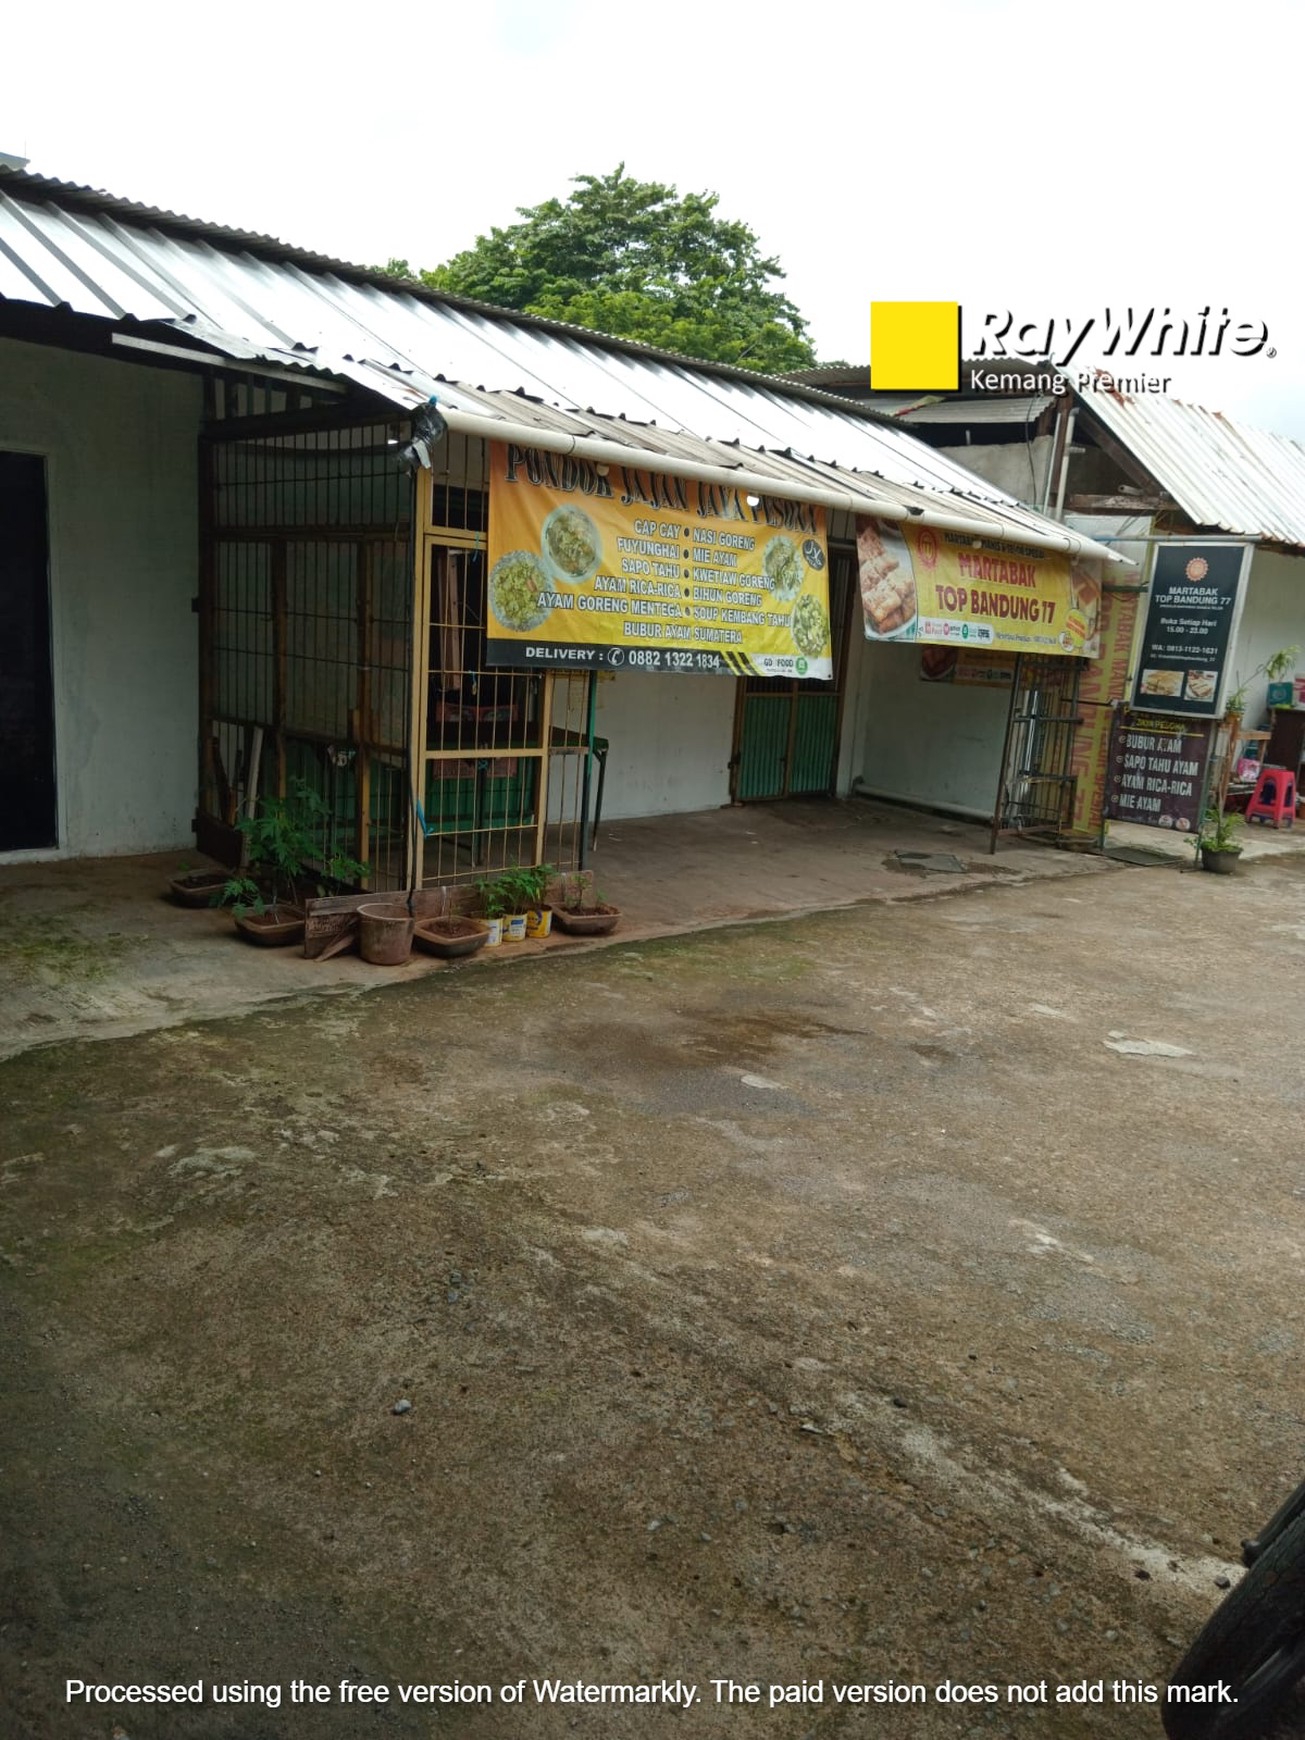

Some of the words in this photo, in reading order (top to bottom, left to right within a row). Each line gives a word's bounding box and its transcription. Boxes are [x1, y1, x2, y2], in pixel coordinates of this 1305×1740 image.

[634, 519, 657, 535] CAP
[659, 523, 681, 539] CAY
[693, 528, 717, 545] NASI
[718, 532, 756, 550] GORENG
[617, 538, 680, 560] FUYUNGHAI
[693, 548, 711, 563] MIE
[713, 551, 738, 567] AYAM
[622, 558, 650, 574] SAPO
[652, 563, 681, 579] TAHU
[693, 568, 737, 586] KWETIAW
[739, 575, 776, 591] GORENG
[958, 552, 1036, 588] MARTABAK
[594, 575, 627, 593] AYAM
[629, 579, 682, 598] RICA-RICA
[693, 586, 723, 603] BIHUN
[726, 591, 763, 607] GORENG
[935, 585, 968, 612] TOP
[971, 589, 1040, 622] BANDUNG
[1155, 594, 1173, 604] TOP
[1174, 595, 1218, 605] BANDUNG
[1219, 597, 1232, 605] 77
[1168, 586, 1219, 596] MARTABAK
[537, 592, 575, 609] AYAM
[577, 595, 628, 613] GORENG
[631, 599, 683, 617] MENTEGA
[694, 607, 718, 621] SOUP
[721, 608, 765, 625] KEMBANG
[767, 612, 792, 628] TAHU
[1114, 571, 1140, 652] MRTABAK
[624, 621, 662, 638] BUBUR
[664, 623, 691, 640] AYAM
[694, 627, 743, 644] SUMATERA
[525, 647, 595, 660] DELIVERY
[628, 650, 661, 665] 0882
[665, 652, 694, 667] 1322
[696, 655, 720, 668] 1834
[1126, 733, 1156, 751] BUBUR
[1123, 753, 1147, 770] SAPO
[1148, 757, 1171, 774] TAHU
[1172, 761, 1199, 777] AYAM
[1121, 773, 1146, 791] AYAM
[1146, 777, 1193, 797] RICA-RICA
[1118, 793, 1136, 809] MIE
[1136, 796, 1161, 813] AYAM
